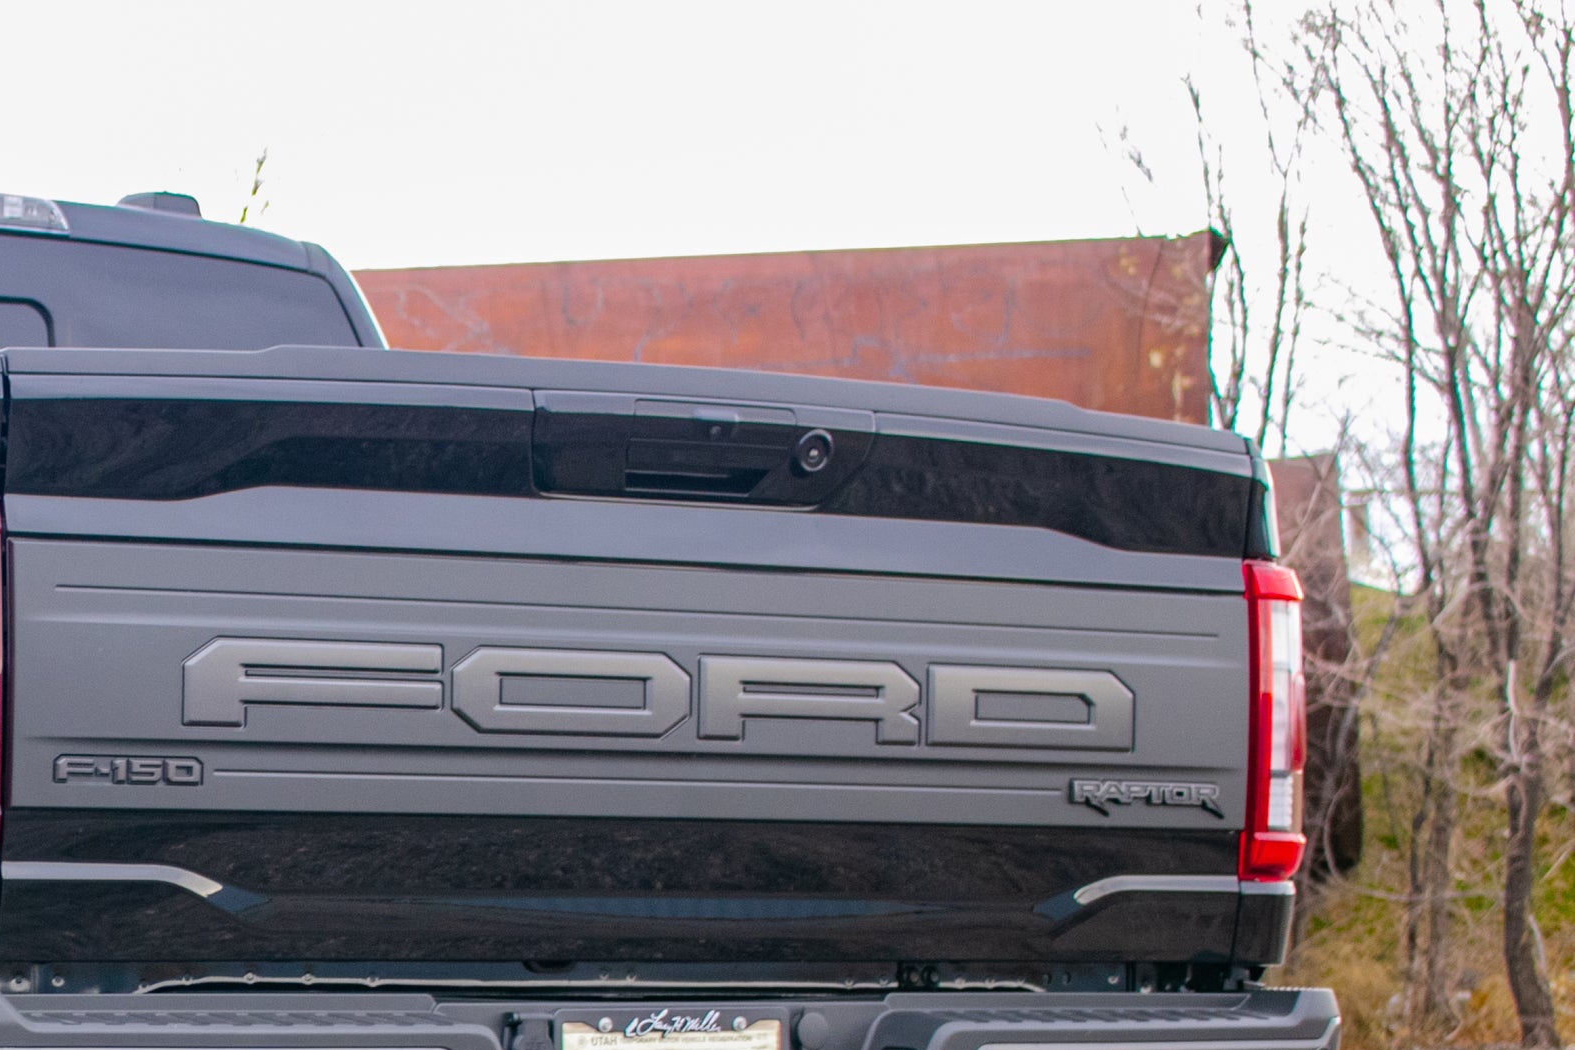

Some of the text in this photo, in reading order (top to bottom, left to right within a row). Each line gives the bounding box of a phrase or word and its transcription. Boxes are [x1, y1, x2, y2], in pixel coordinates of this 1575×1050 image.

[181, 635, 1136, 753] FORD
[53, 754, 204, 786] F-150
[1069, 778, 1224, 820] RAPTOR
[591, 1035, 618, 1047] UTAH
